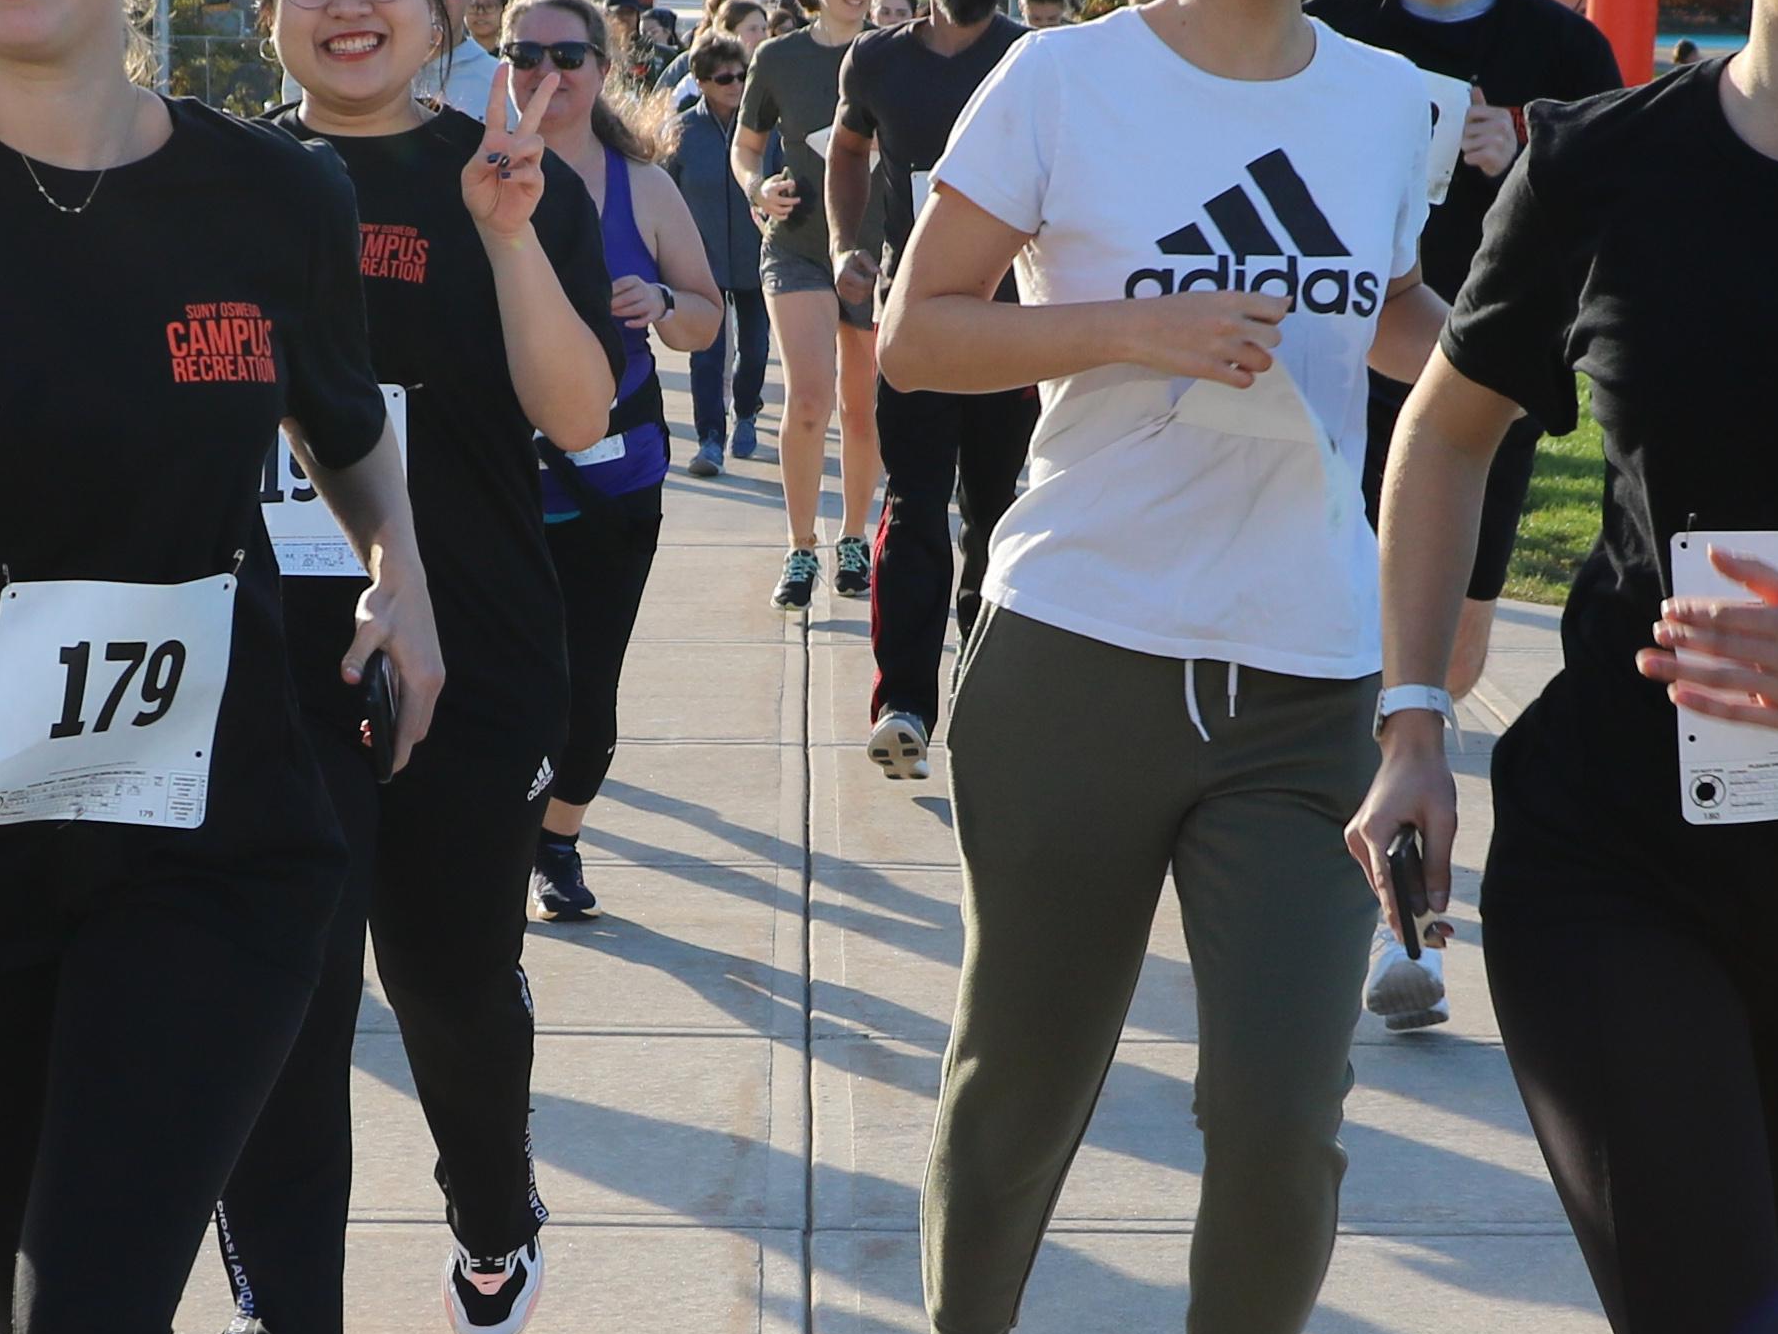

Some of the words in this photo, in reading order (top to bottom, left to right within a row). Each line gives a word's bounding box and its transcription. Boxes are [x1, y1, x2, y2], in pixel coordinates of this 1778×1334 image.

[359, 233, 430, 265] MPUS
[359, 257, 426, 283] REATION
[1124, 254, 1379, 318] adidas
[185, 303, 218, 319] SUNY
[166, 318, 272, 357] CAMPUS
[172, 355, 277, 383] RECREATION
[49, 639, 186, 740] 179
